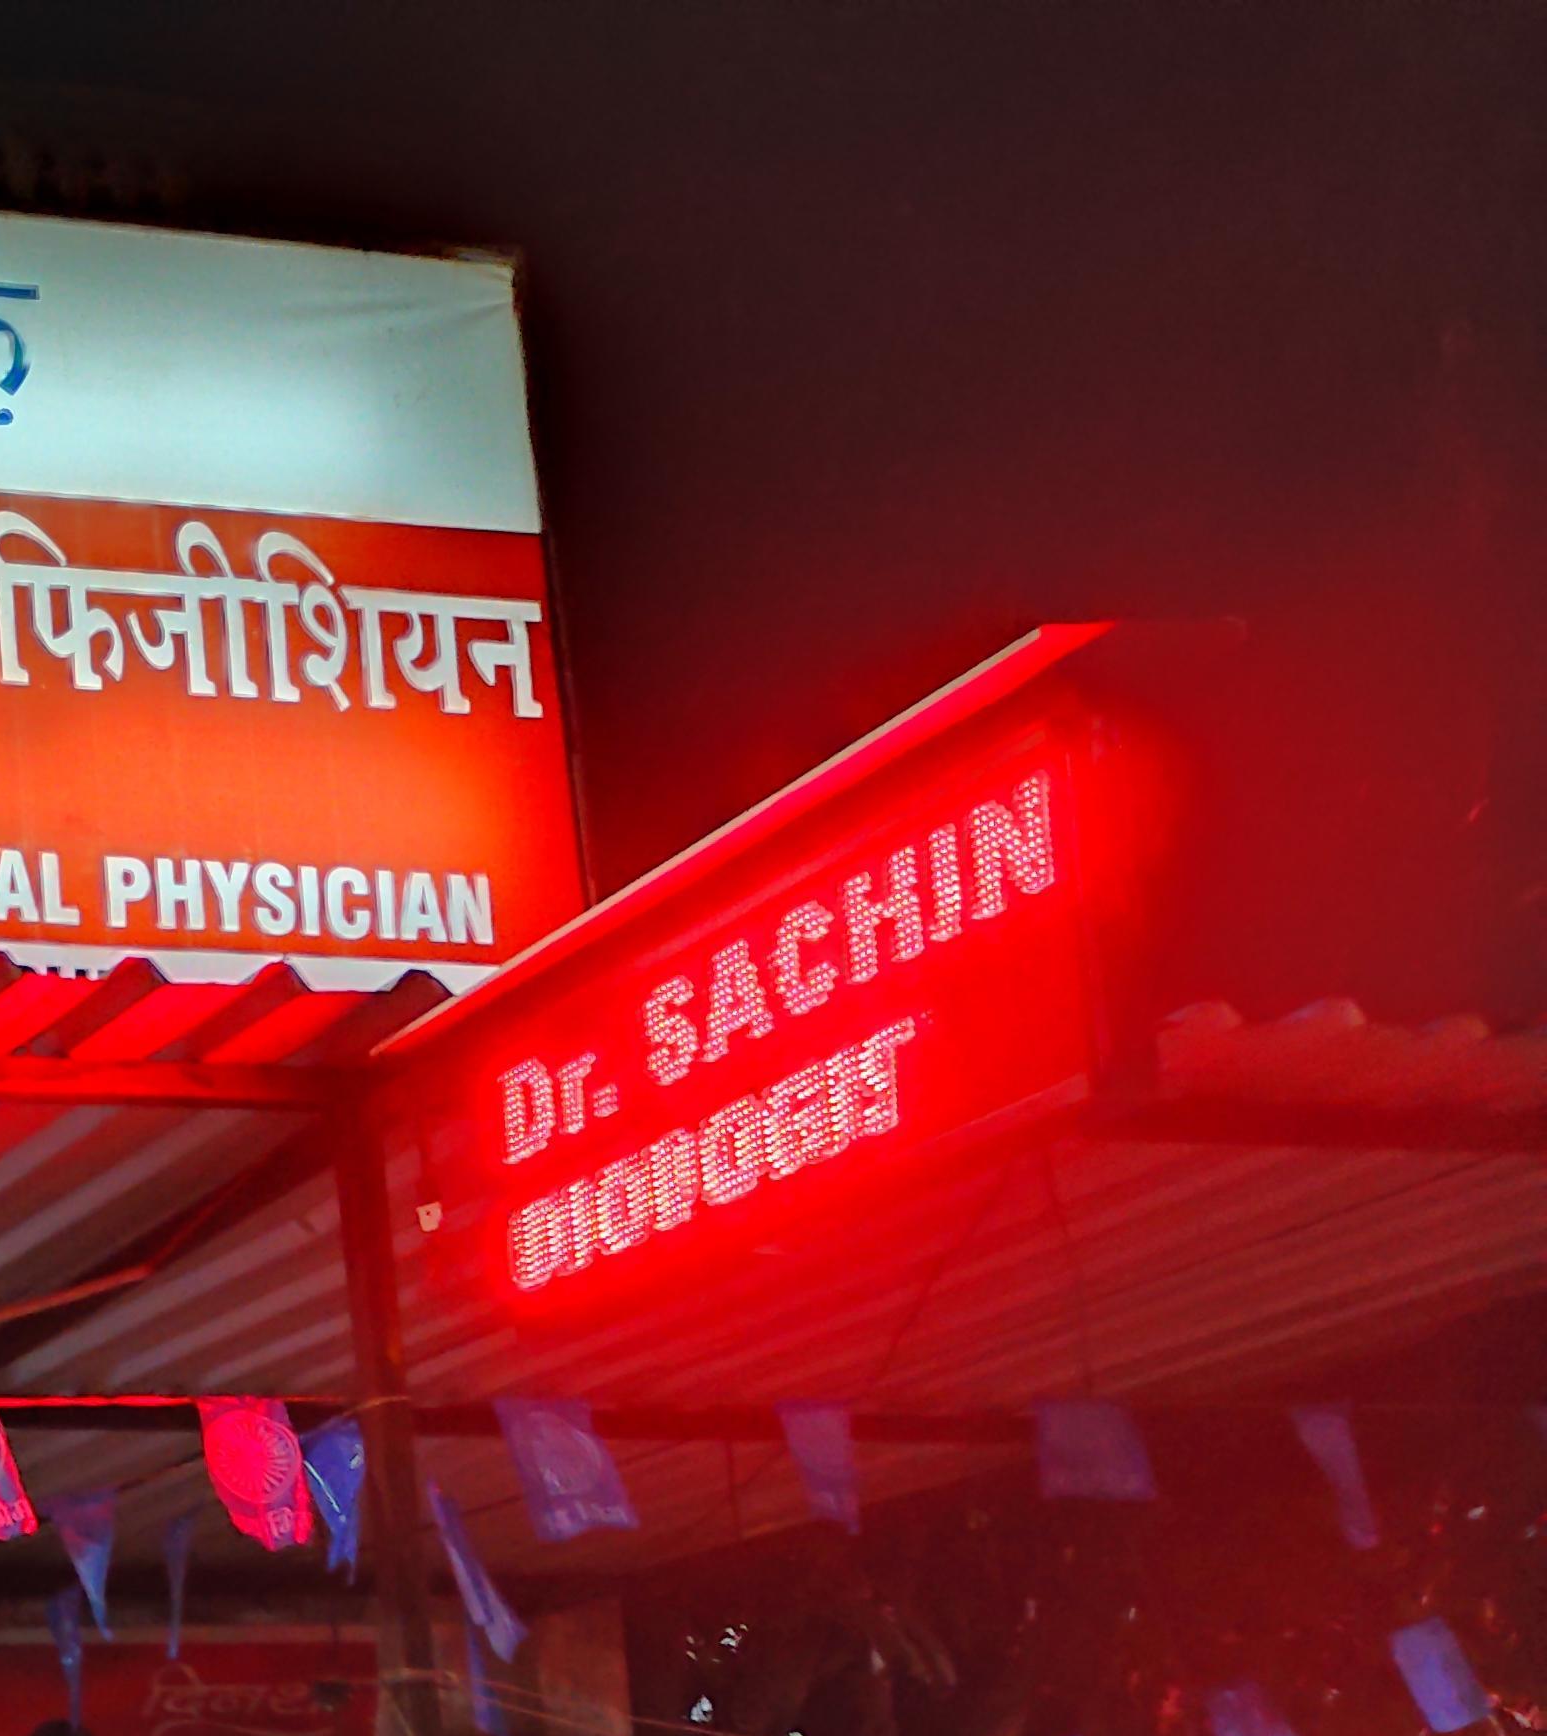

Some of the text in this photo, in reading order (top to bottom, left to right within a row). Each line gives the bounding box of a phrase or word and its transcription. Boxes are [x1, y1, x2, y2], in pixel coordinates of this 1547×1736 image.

[103, 853, 495, 946] PHYSICIAN
[497, 1050, 620, 1166] Dr.
[641, 770, 1056, 1087] SACHIN
